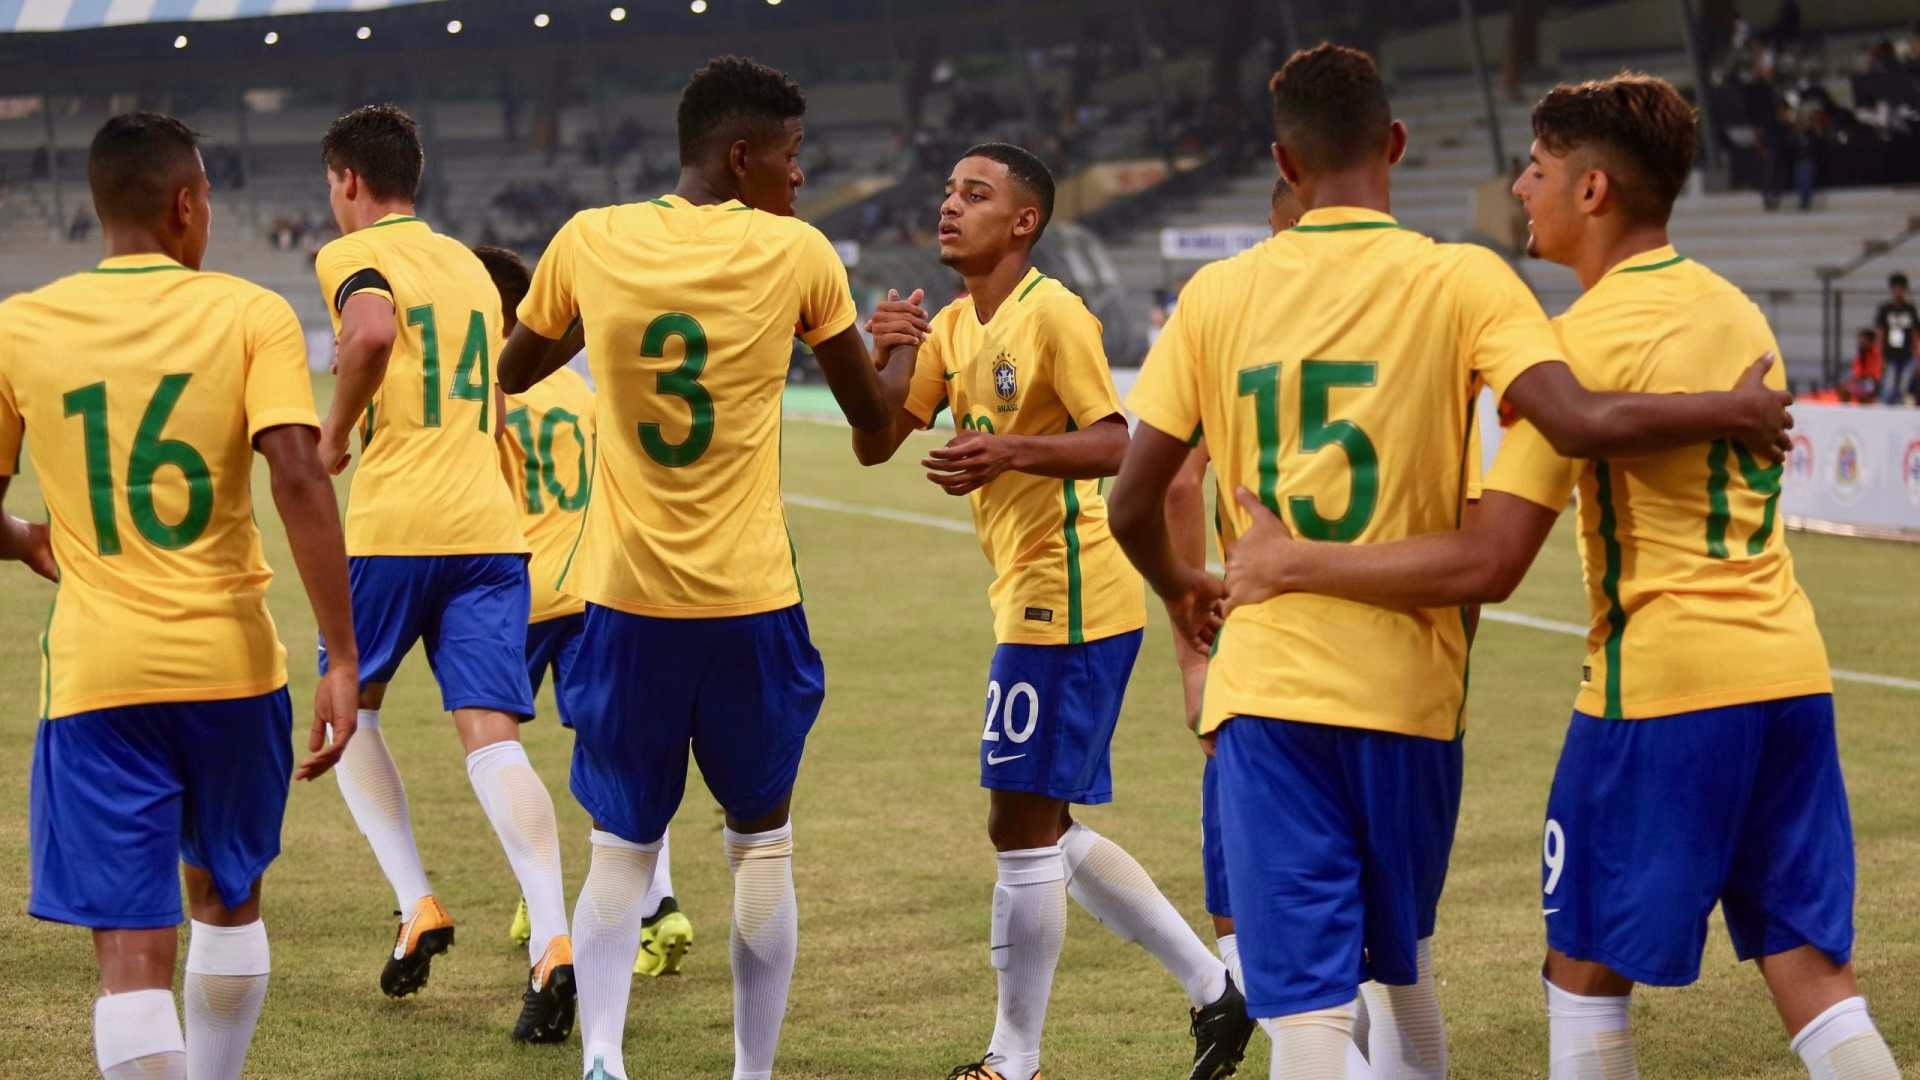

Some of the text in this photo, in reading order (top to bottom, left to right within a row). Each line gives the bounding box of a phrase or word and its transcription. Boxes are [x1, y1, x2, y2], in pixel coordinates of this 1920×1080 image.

[406, 303, 489, 434] 14
[637, 312, 715, 468] 3
[62, 373, 214, 556] 16
[505, 405, 588, 514] 10
[1238, 359, 1379, 543] 15
[982, 680, 1039, 744] 20
[1544, 818, 1565, 895] 9
